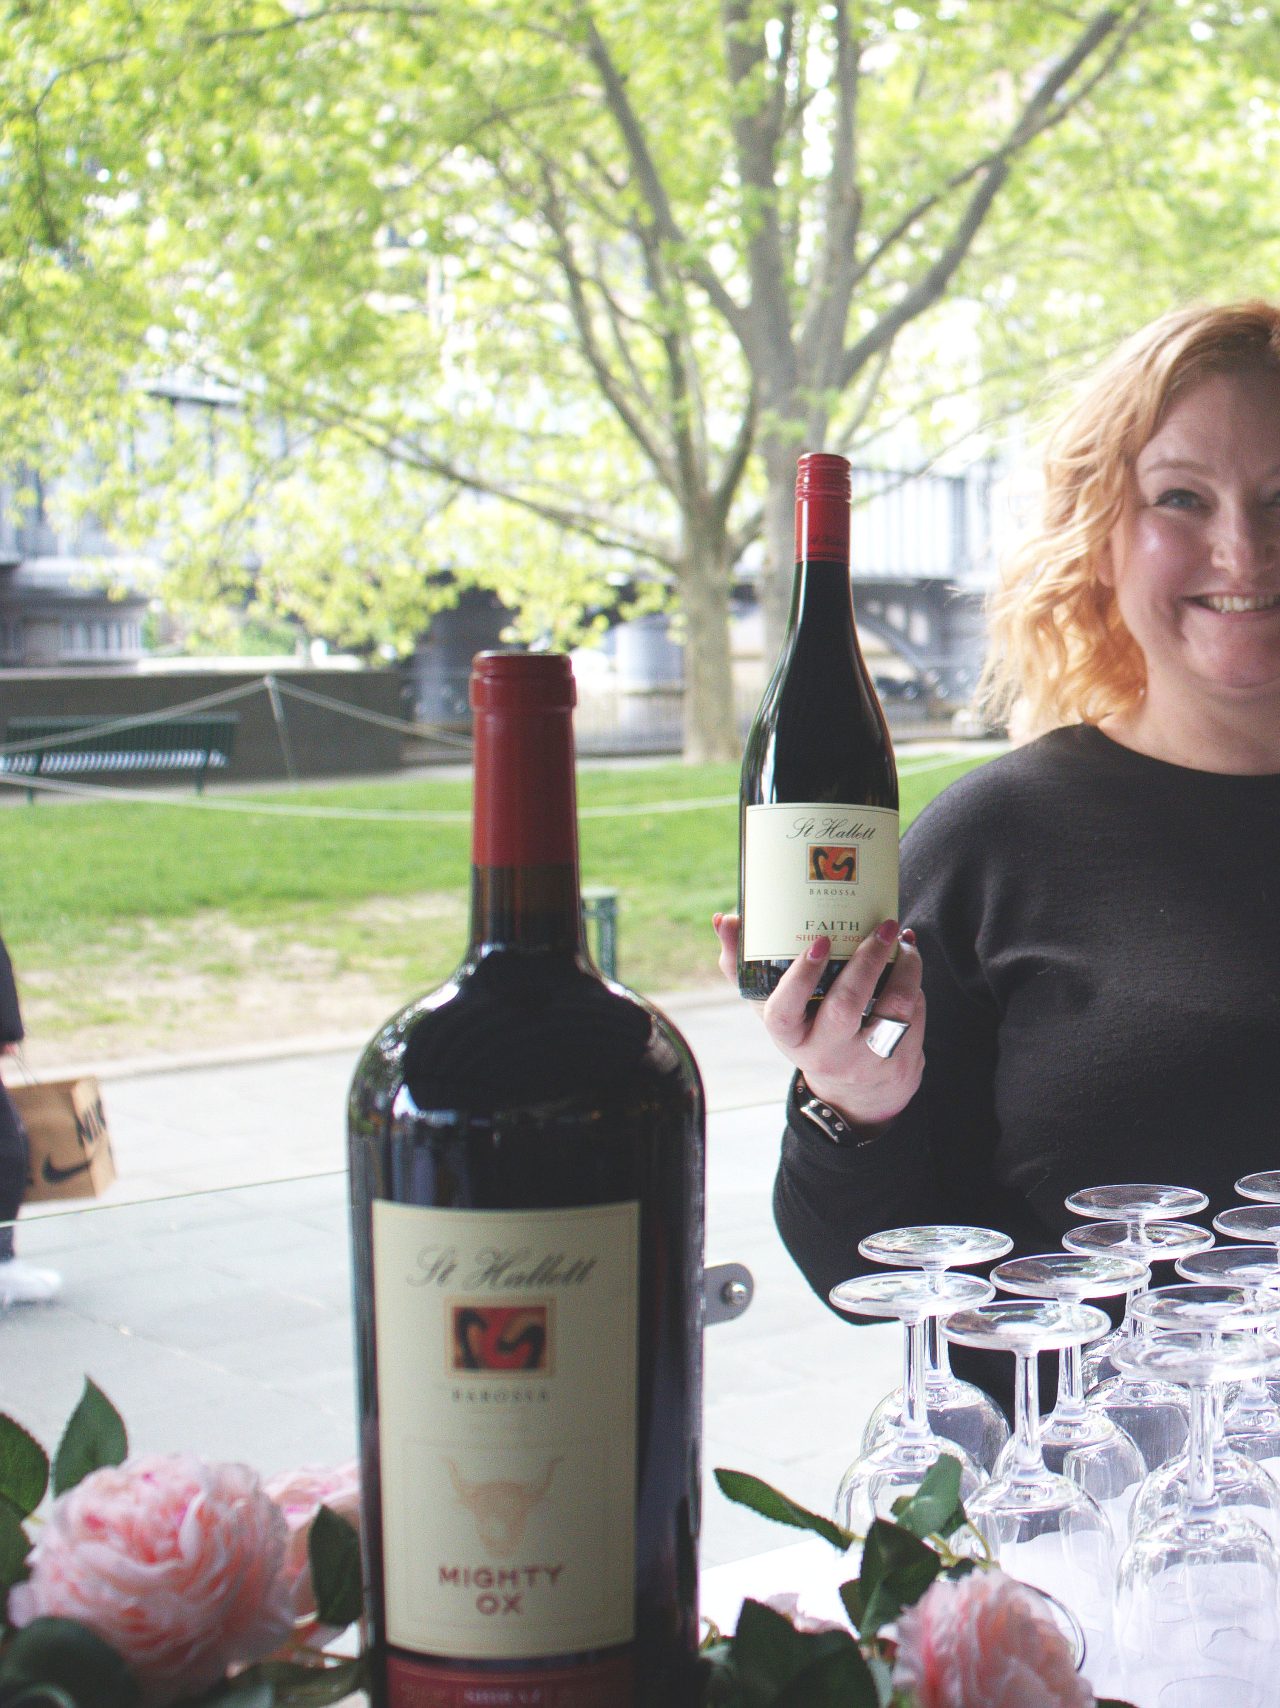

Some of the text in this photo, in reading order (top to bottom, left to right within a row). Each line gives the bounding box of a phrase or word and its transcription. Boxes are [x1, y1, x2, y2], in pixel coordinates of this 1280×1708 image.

[786, 817, 877, 841] St Hallett
[809, 888, 857, 897] BAROSSA
[795, 933, 838, 942] SHIZ
[805, 920, 860, 932] FAITH
[463, 1244, 600, 1291] Hallett
[438, 1566, 564, 1589] MIGHTY
[475, 1593, 524, 1617] OX
